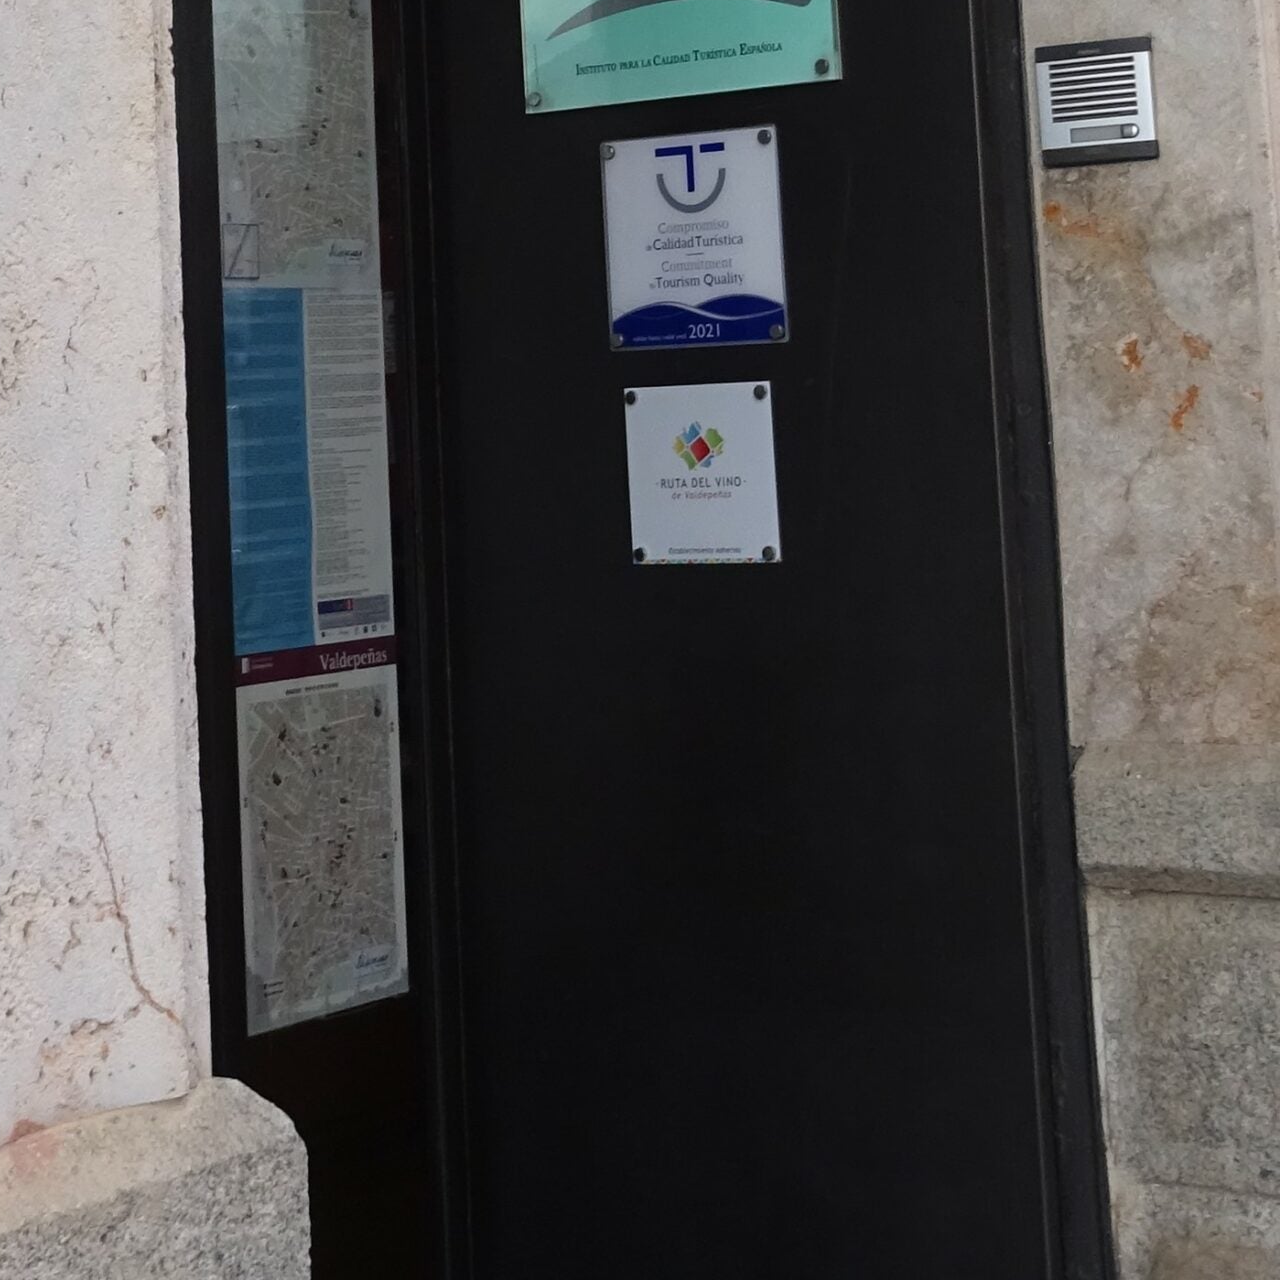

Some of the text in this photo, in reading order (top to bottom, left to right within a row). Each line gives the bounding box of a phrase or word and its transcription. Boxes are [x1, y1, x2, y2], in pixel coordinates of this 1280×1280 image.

[657, 220, 730, 235] Compromiso
[652, 236, 695, 251] Calidad
[695, 233, 744, 249] Turística
[661, 258, 733, 273] Commitment
[655, 275, 701, 289] Tourism
[703, 271, 745, 287] Quality
[687, 322, 721, 339] 2021
[659, 475, 742, 489] RUTA DEL VINO
[320, 647, 388, 671] Valdepeñas
